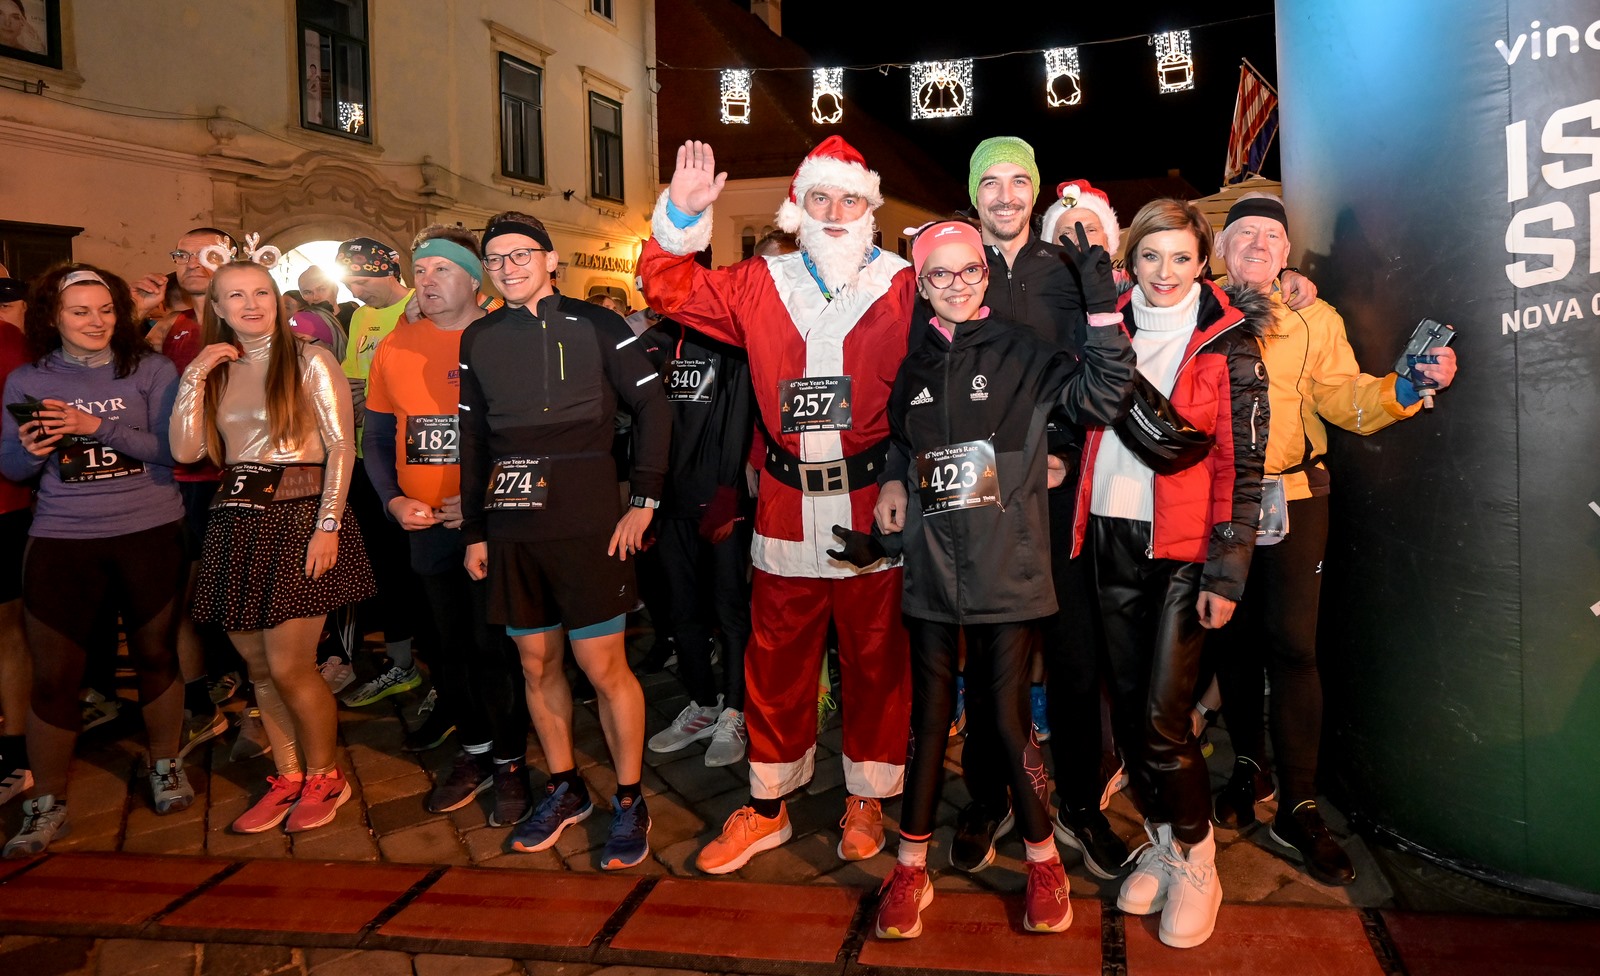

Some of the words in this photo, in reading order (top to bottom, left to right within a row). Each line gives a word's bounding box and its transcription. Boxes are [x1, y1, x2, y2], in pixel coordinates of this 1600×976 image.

[1505, 193, 1600, 289] S
[1502, 298, 1584, 335] NOVA
[670, 370, 701, 388] 340
[793, 392, 836, 418] 257
[910, 396, 934, 406] adidas
[417, 429, 457, 450] 182
[83, 446, 118, 468] 15
[931, 450, 945, 458] New
[944, 447, 963, 456] Year's
[963, 445, 978, 453] Race
[258, 465, 272, 473] Race
[931, 461, 978, 493] 423
[230, 475, 248, 495] 5
[493, 471, 532, 495] 274
